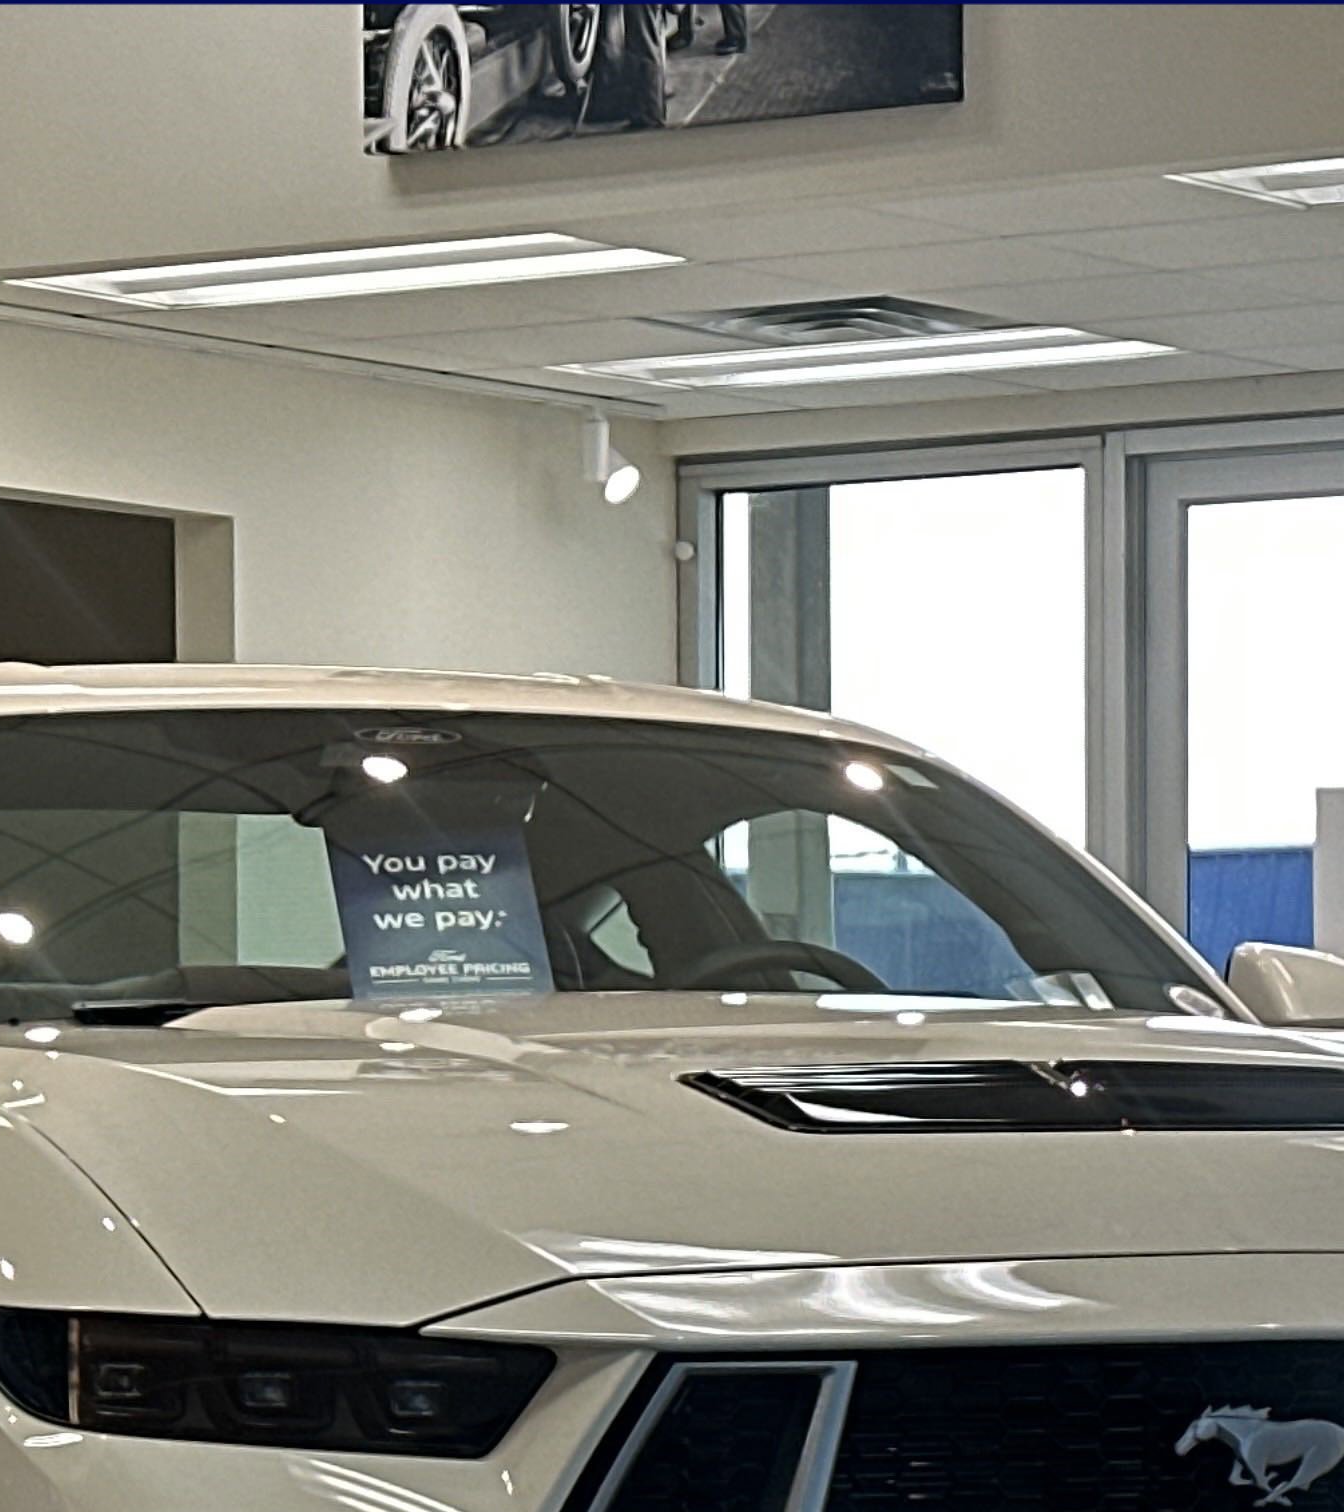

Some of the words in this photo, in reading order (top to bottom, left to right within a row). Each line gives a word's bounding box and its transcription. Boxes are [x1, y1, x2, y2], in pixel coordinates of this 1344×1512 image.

[362, 853, 426, 874] You
[436, 854, 497, 875] pay
[392, 878, 481, 901] what
[373, 911, 426, 930] we
[369, 963, 457, 978] EMPLOYEE
[463, 962, 531, 976] PRICING
